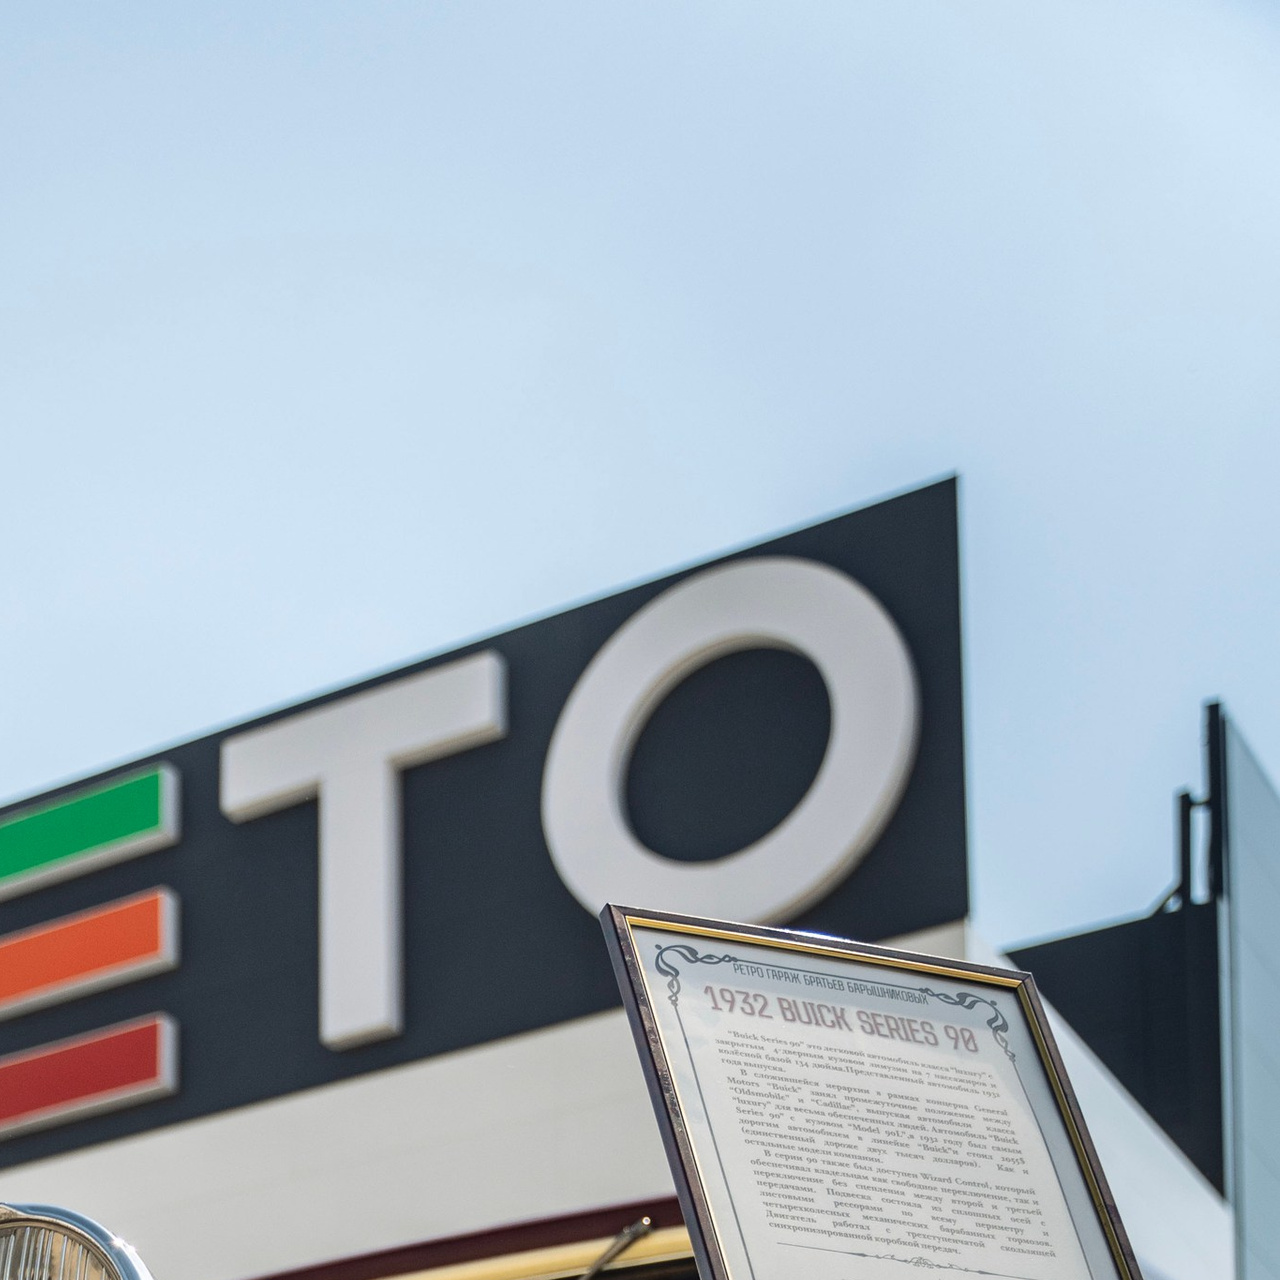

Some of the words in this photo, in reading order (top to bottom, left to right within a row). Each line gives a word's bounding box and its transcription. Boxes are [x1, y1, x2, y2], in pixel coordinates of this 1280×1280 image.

[733, 963, 763, 979] РЕТРО
[767, 968, 802, 985] ГАРАЖ
[803, 974, 845, 991] БРАТЬЕВ
[847, 981, 929, 1005] БАРЫШНИКОВЫХ
[704, 986, 773, 1019] 1932
[777, 997, 852, 1032] BUICK
[856, 1009, 939, 1047] SERIES
[944, 1025, 979, 1053] 90
